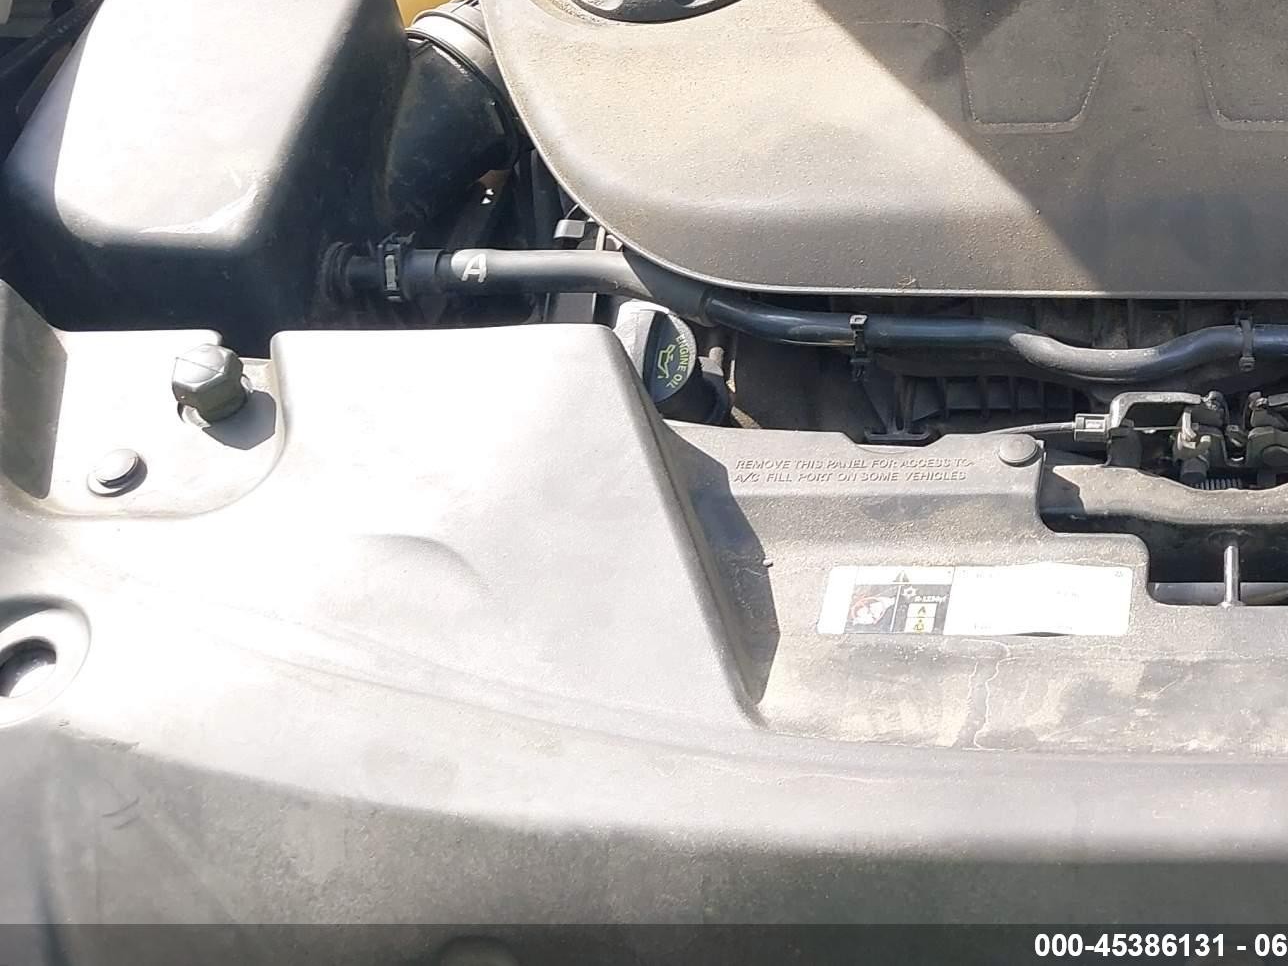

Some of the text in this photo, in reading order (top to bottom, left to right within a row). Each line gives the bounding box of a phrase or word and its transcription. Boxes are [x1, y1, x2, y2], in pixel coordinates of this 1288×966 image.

[461, 253, 487, 283] A
[666, 334, 690, 389] ENGINE OIL
[735, 458, 792, 470] REMOVE
[795, 458, 824, 470] THIS
[827, 458, 868, 470] PANEL
[872, 458, 897, 469] FOR
[900, 458, 951, 469] ACCESS
[734, 471, 967, 483] A/C FILL PORT ON SOME VEHICLES
